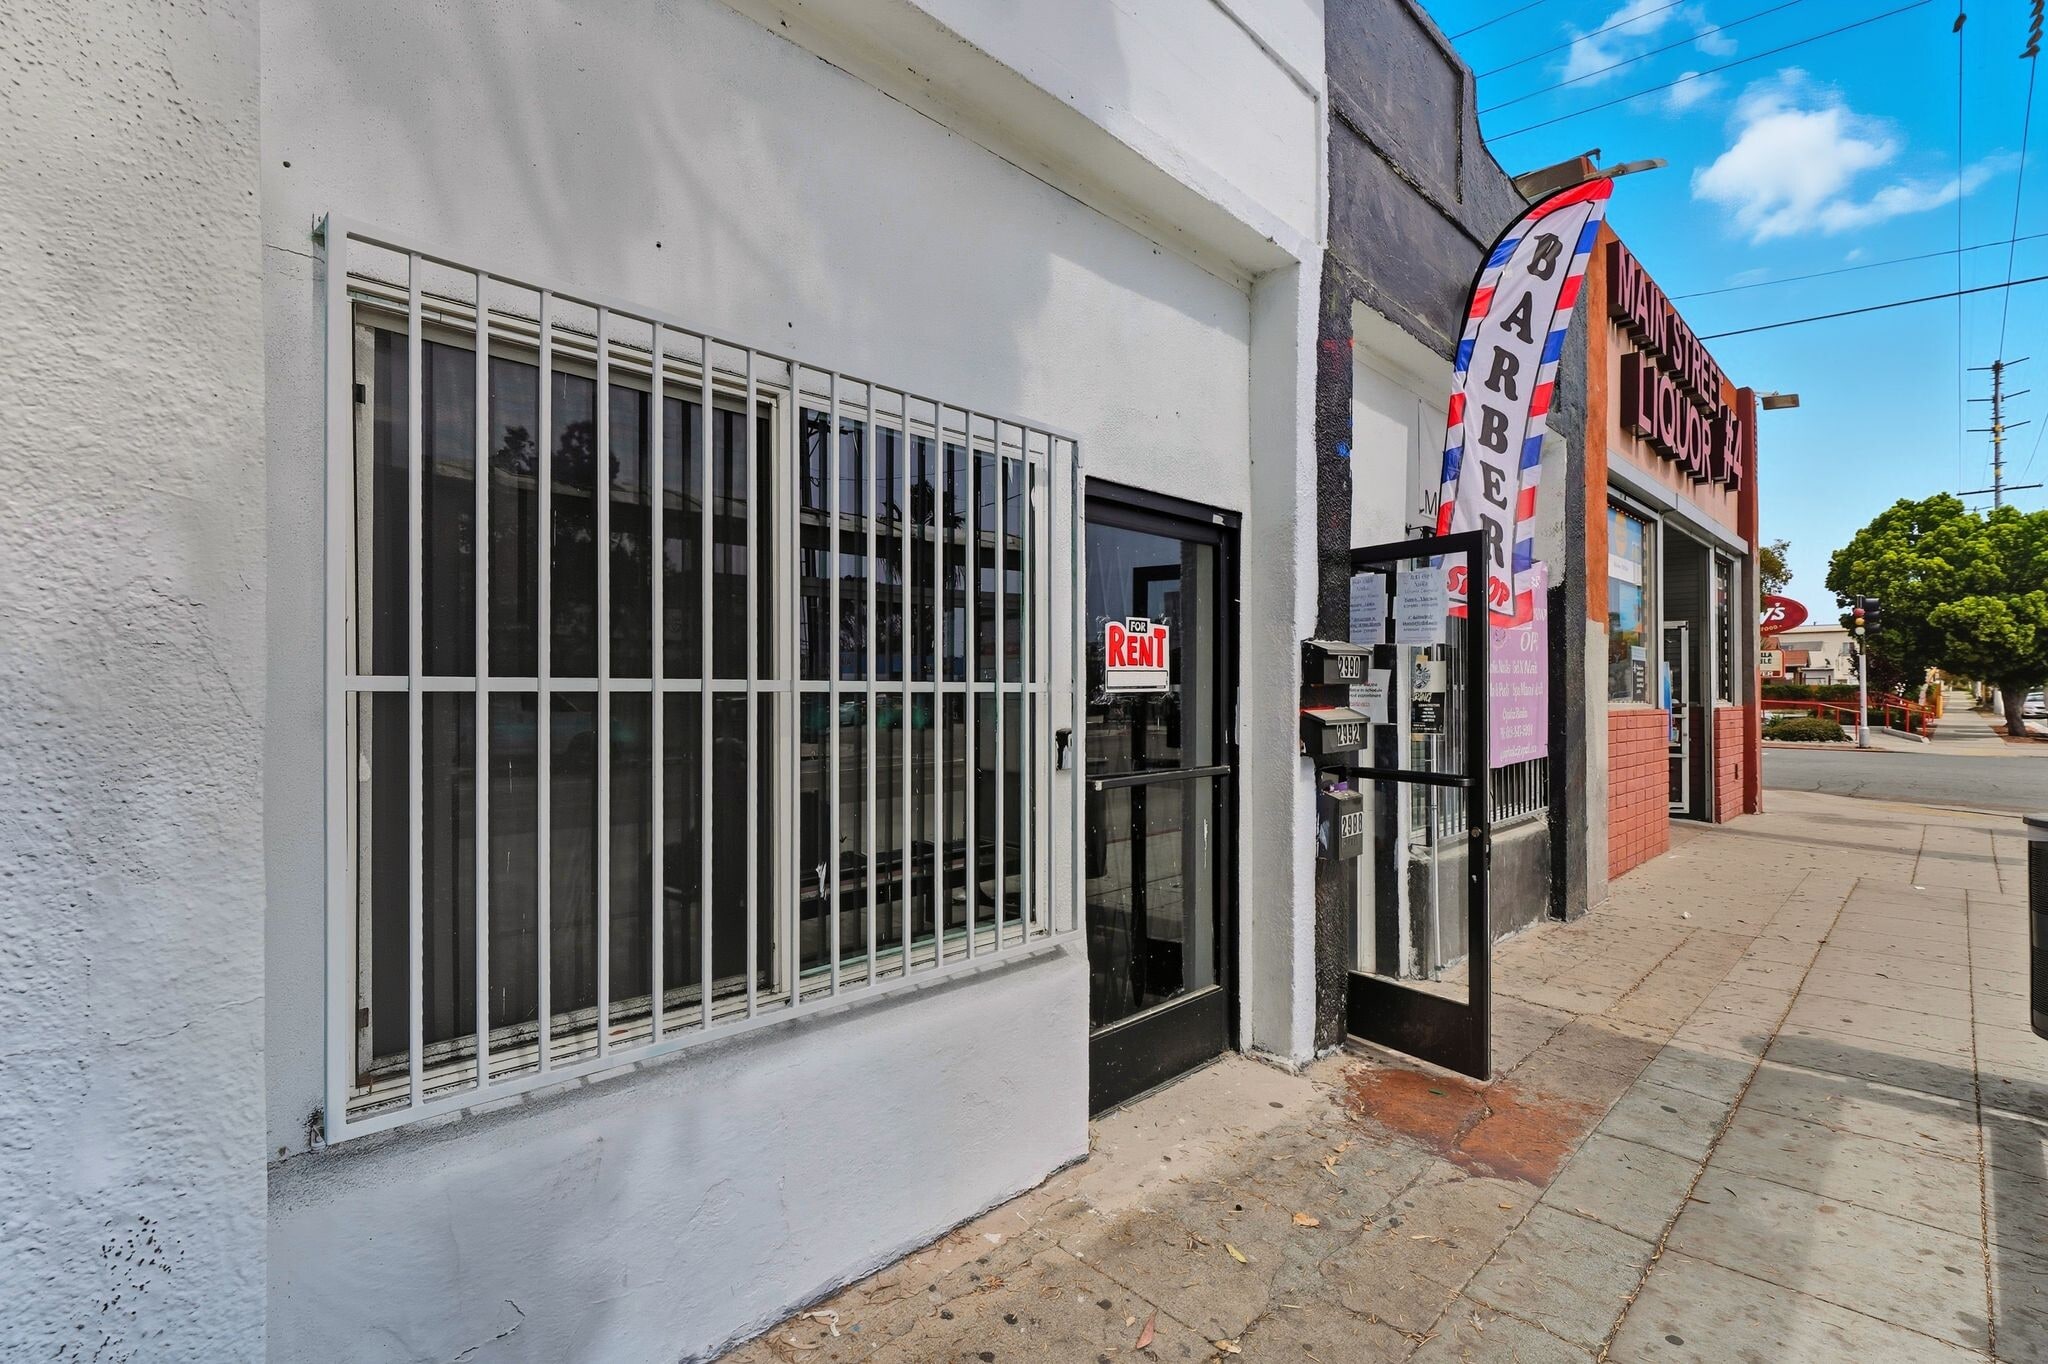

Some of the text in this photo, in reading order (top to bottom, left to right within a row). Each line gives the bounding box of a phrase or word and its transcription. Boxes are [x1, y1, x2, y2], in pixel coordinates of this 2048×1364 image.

[1616, 241, 1724, 413] MAIN STREET
[1478, 233, 1564, 569] BARBER
[1637, 364, 1743, 490] LIQUOR #4
[1130, 621, 1147, 632] FOR
[1108, 625, 1167, 667] RENT
[1337, 656, 1360, 677] 2990
[1337, 724, 1360, 745] 2992
[1341, 812, 1363, 838] 2988
